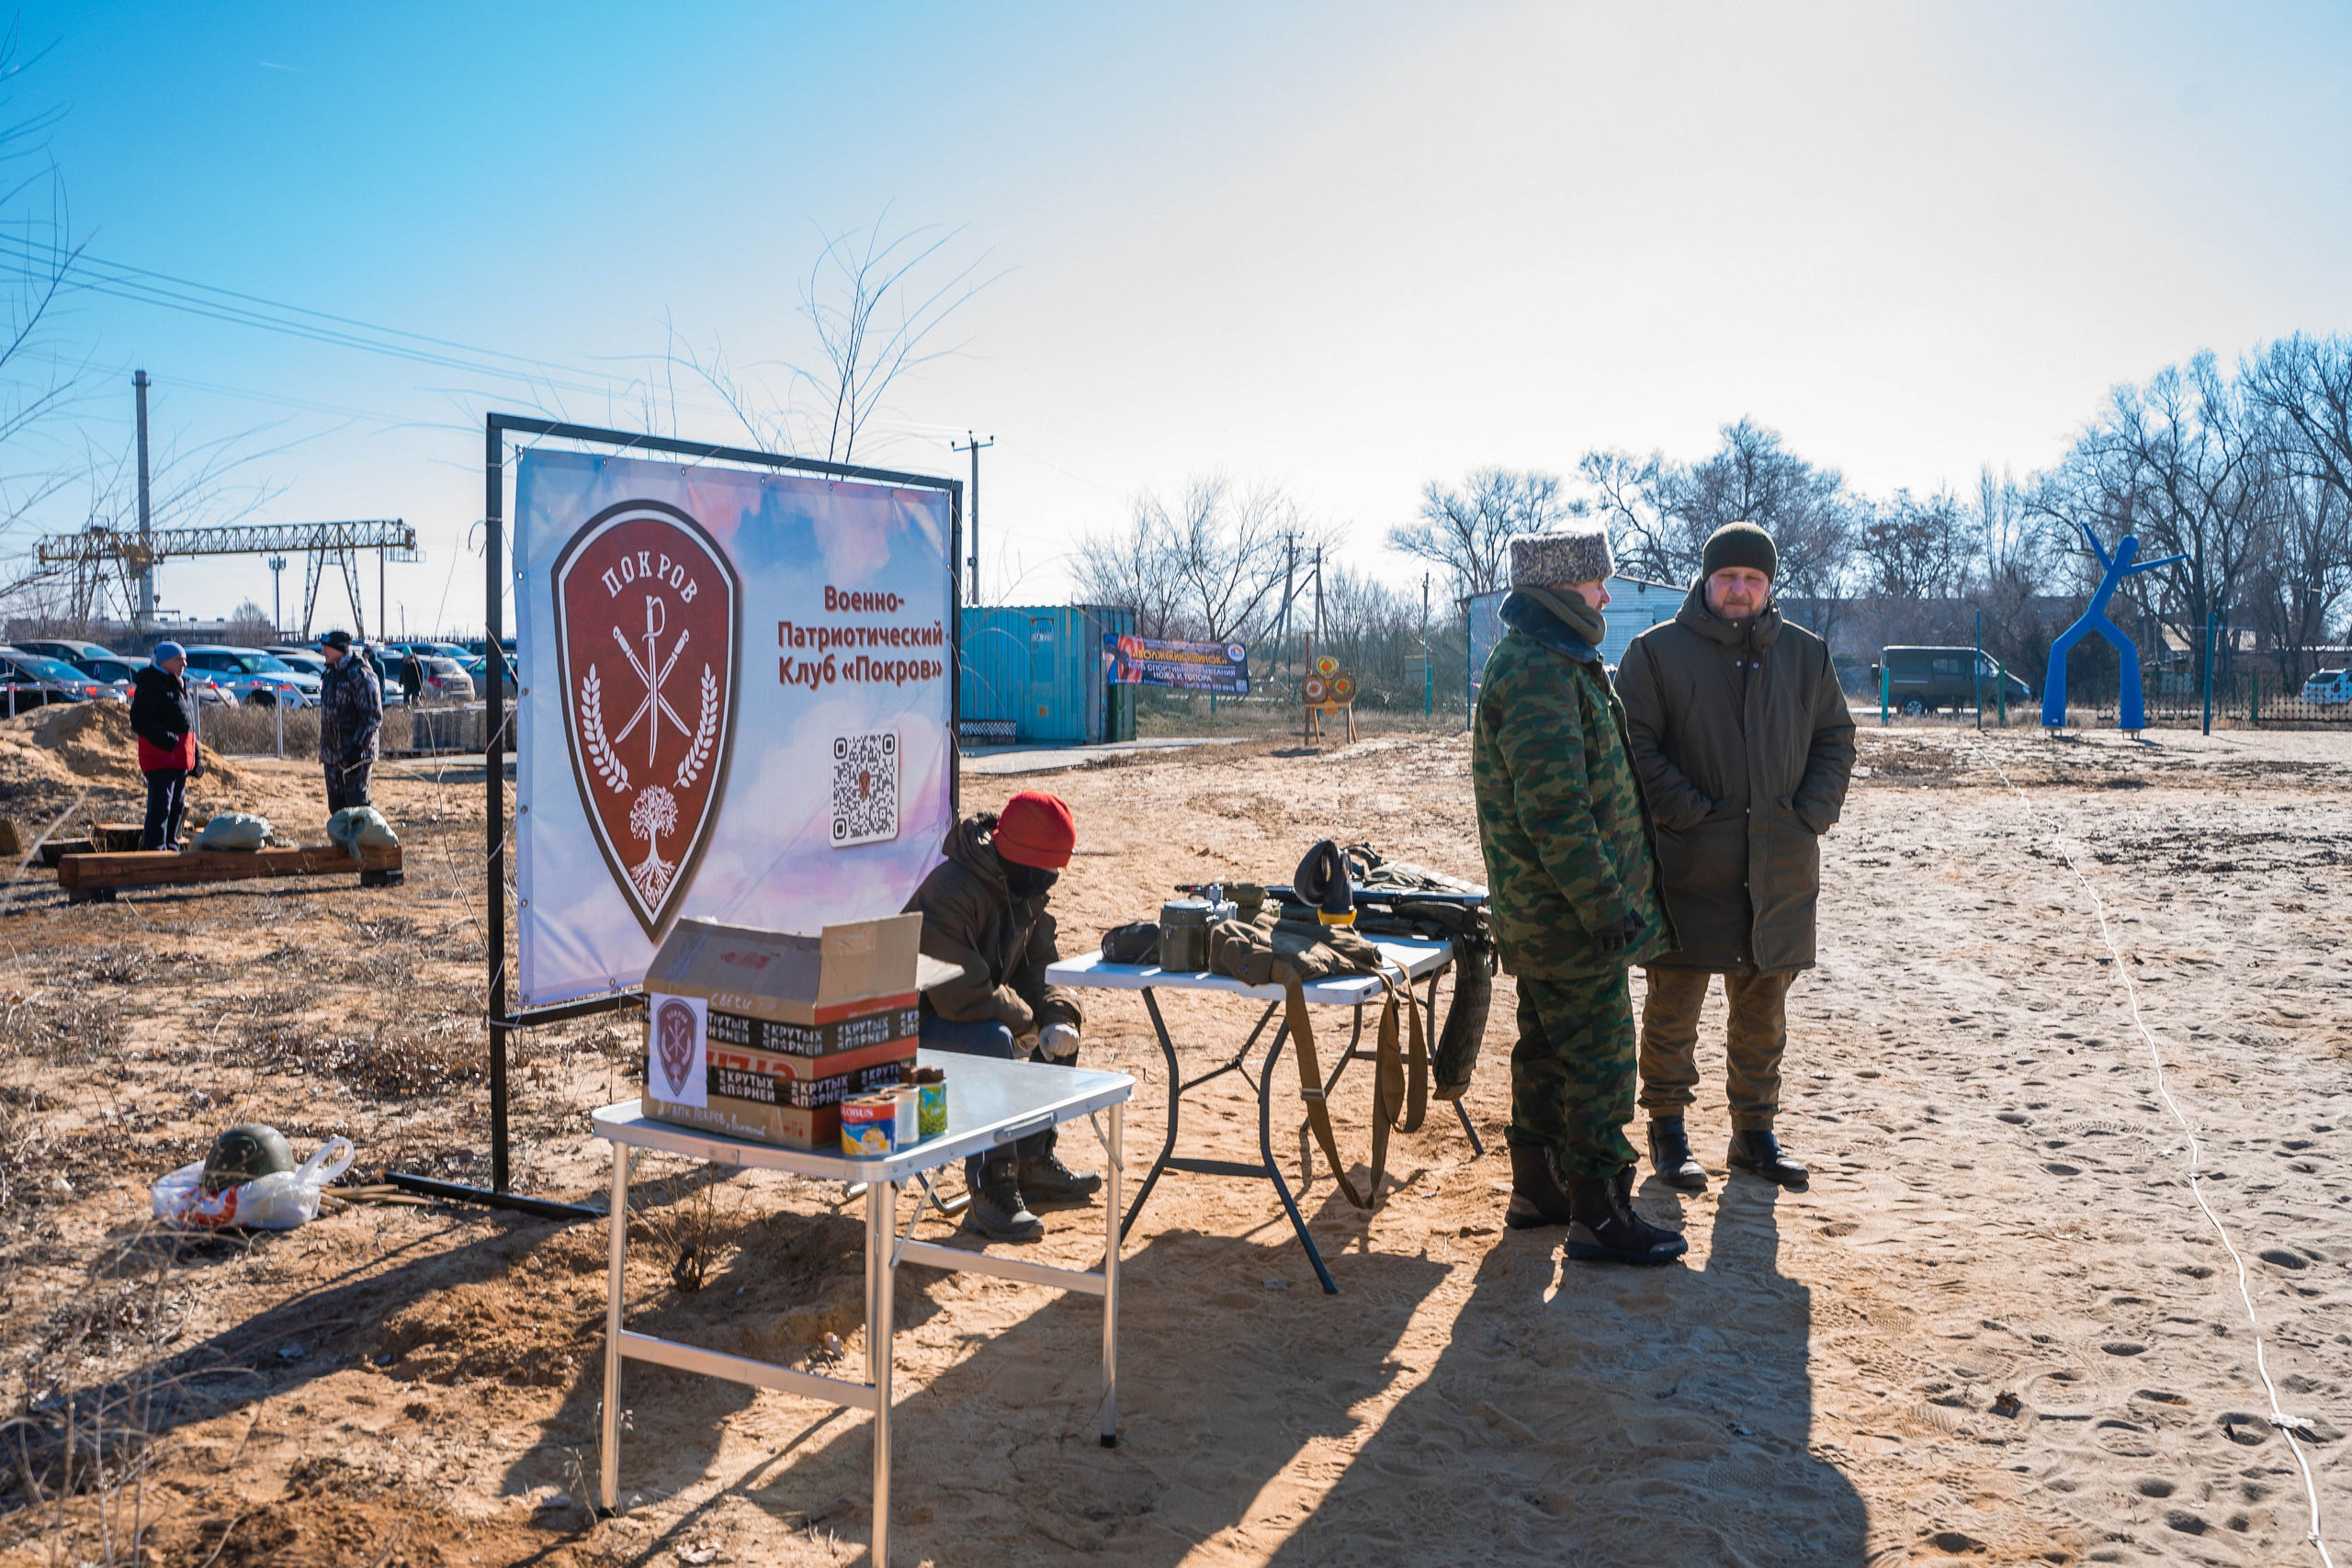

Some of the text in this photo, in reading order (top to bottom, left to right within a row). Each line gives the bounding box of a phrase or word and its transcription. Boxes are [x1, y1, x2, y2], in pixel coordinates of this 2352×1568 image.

[602, 551, 697, 604] ПОКРОВ
[824, 585, 905, 613] Военно-
[779, 620, 943, 653] Патриотический
[779, 653, 943, 691] Клуб «Покров»
[772, 1024, 823, 1043] КРУТЫХ
[845, 1016, 888, 1036] КРУТЫХ
[727, 1070, 775, 1089] КРУТЫХ
[800, 1075, 848, 1095] КРУТЫХ
